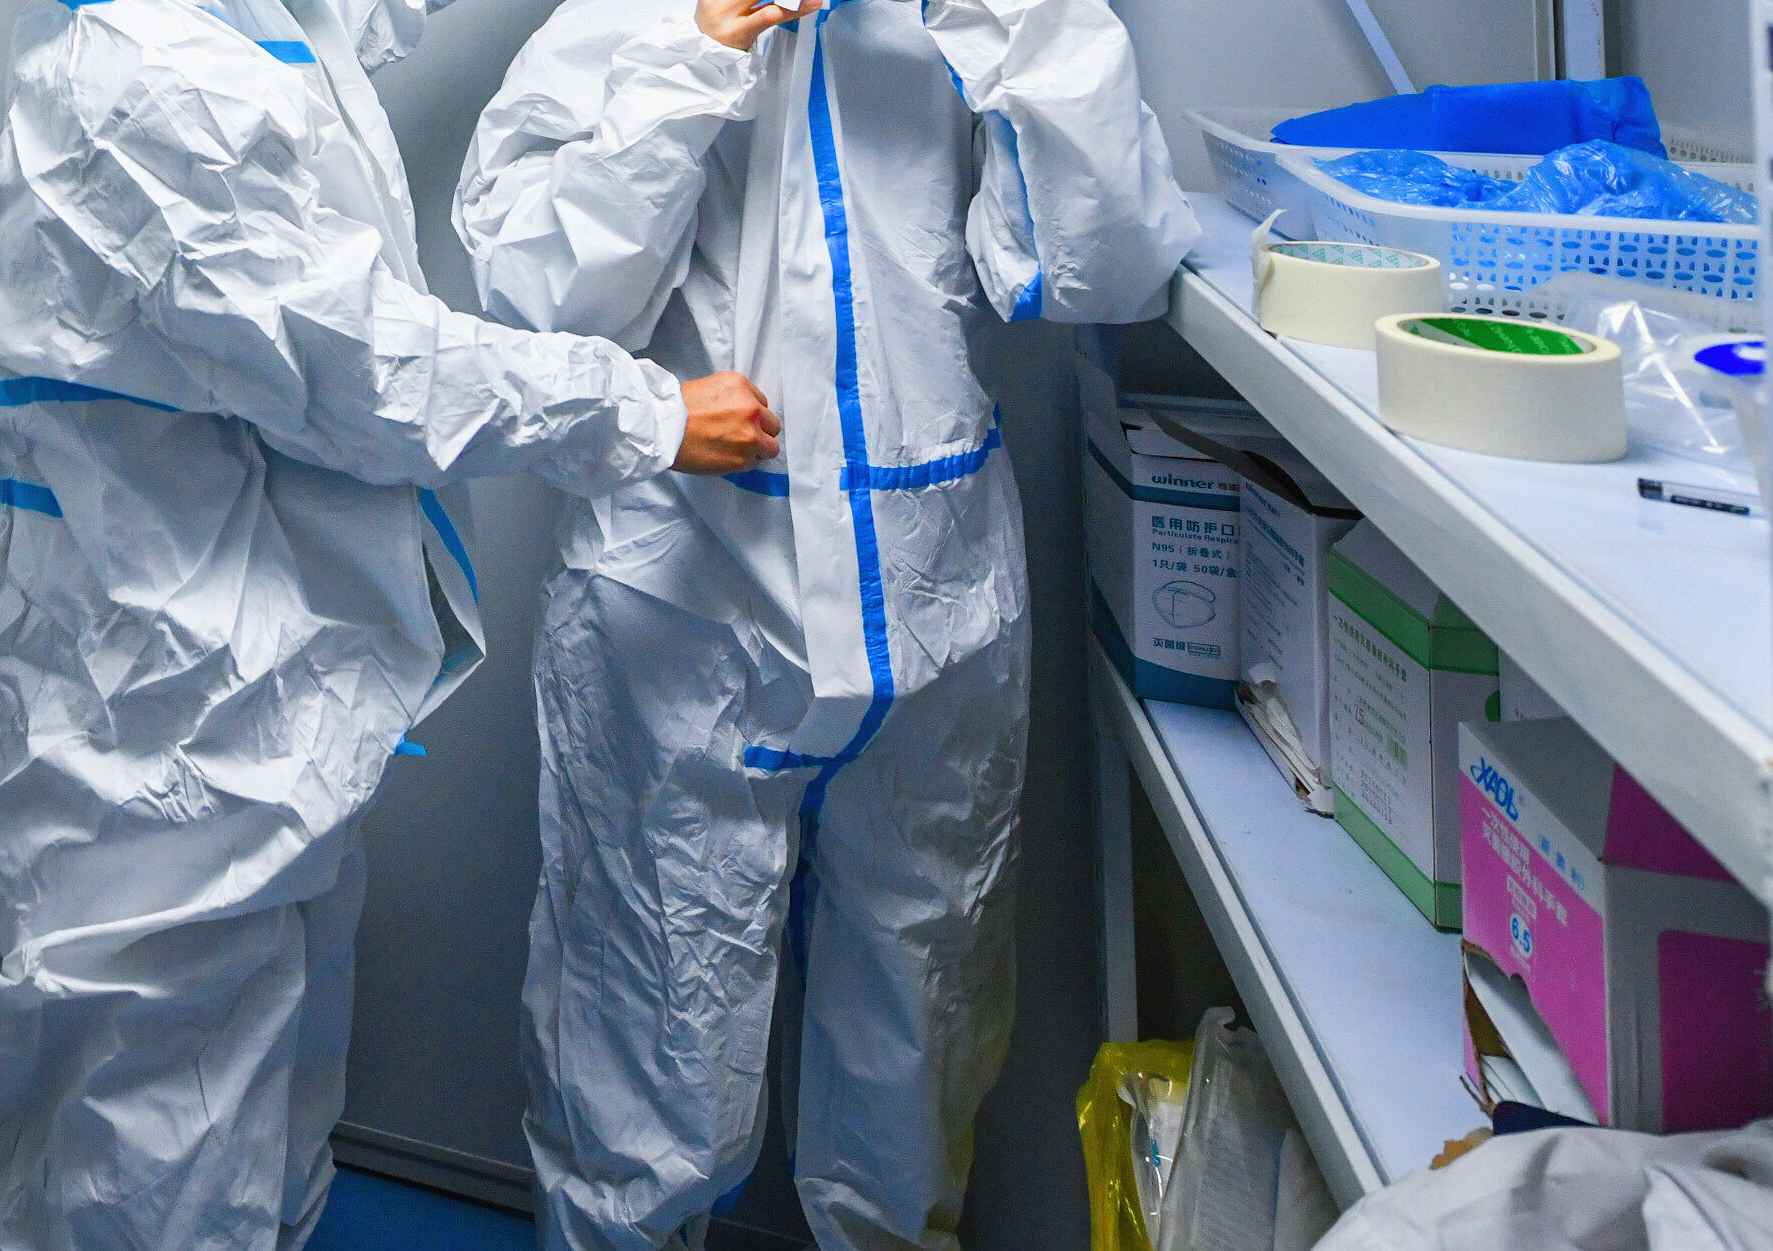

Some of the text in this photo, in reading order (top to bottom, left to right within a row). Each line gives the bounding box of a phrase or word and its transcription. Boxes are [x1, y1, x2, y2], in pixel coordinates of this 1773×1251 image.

[1151, 473, 1215, 489] winner
[1151, 515, 1241, 536] 医用防护口
[1152, 528, 1202, 541] Particulate
[1512, 916, 1531, 953] 6.5
